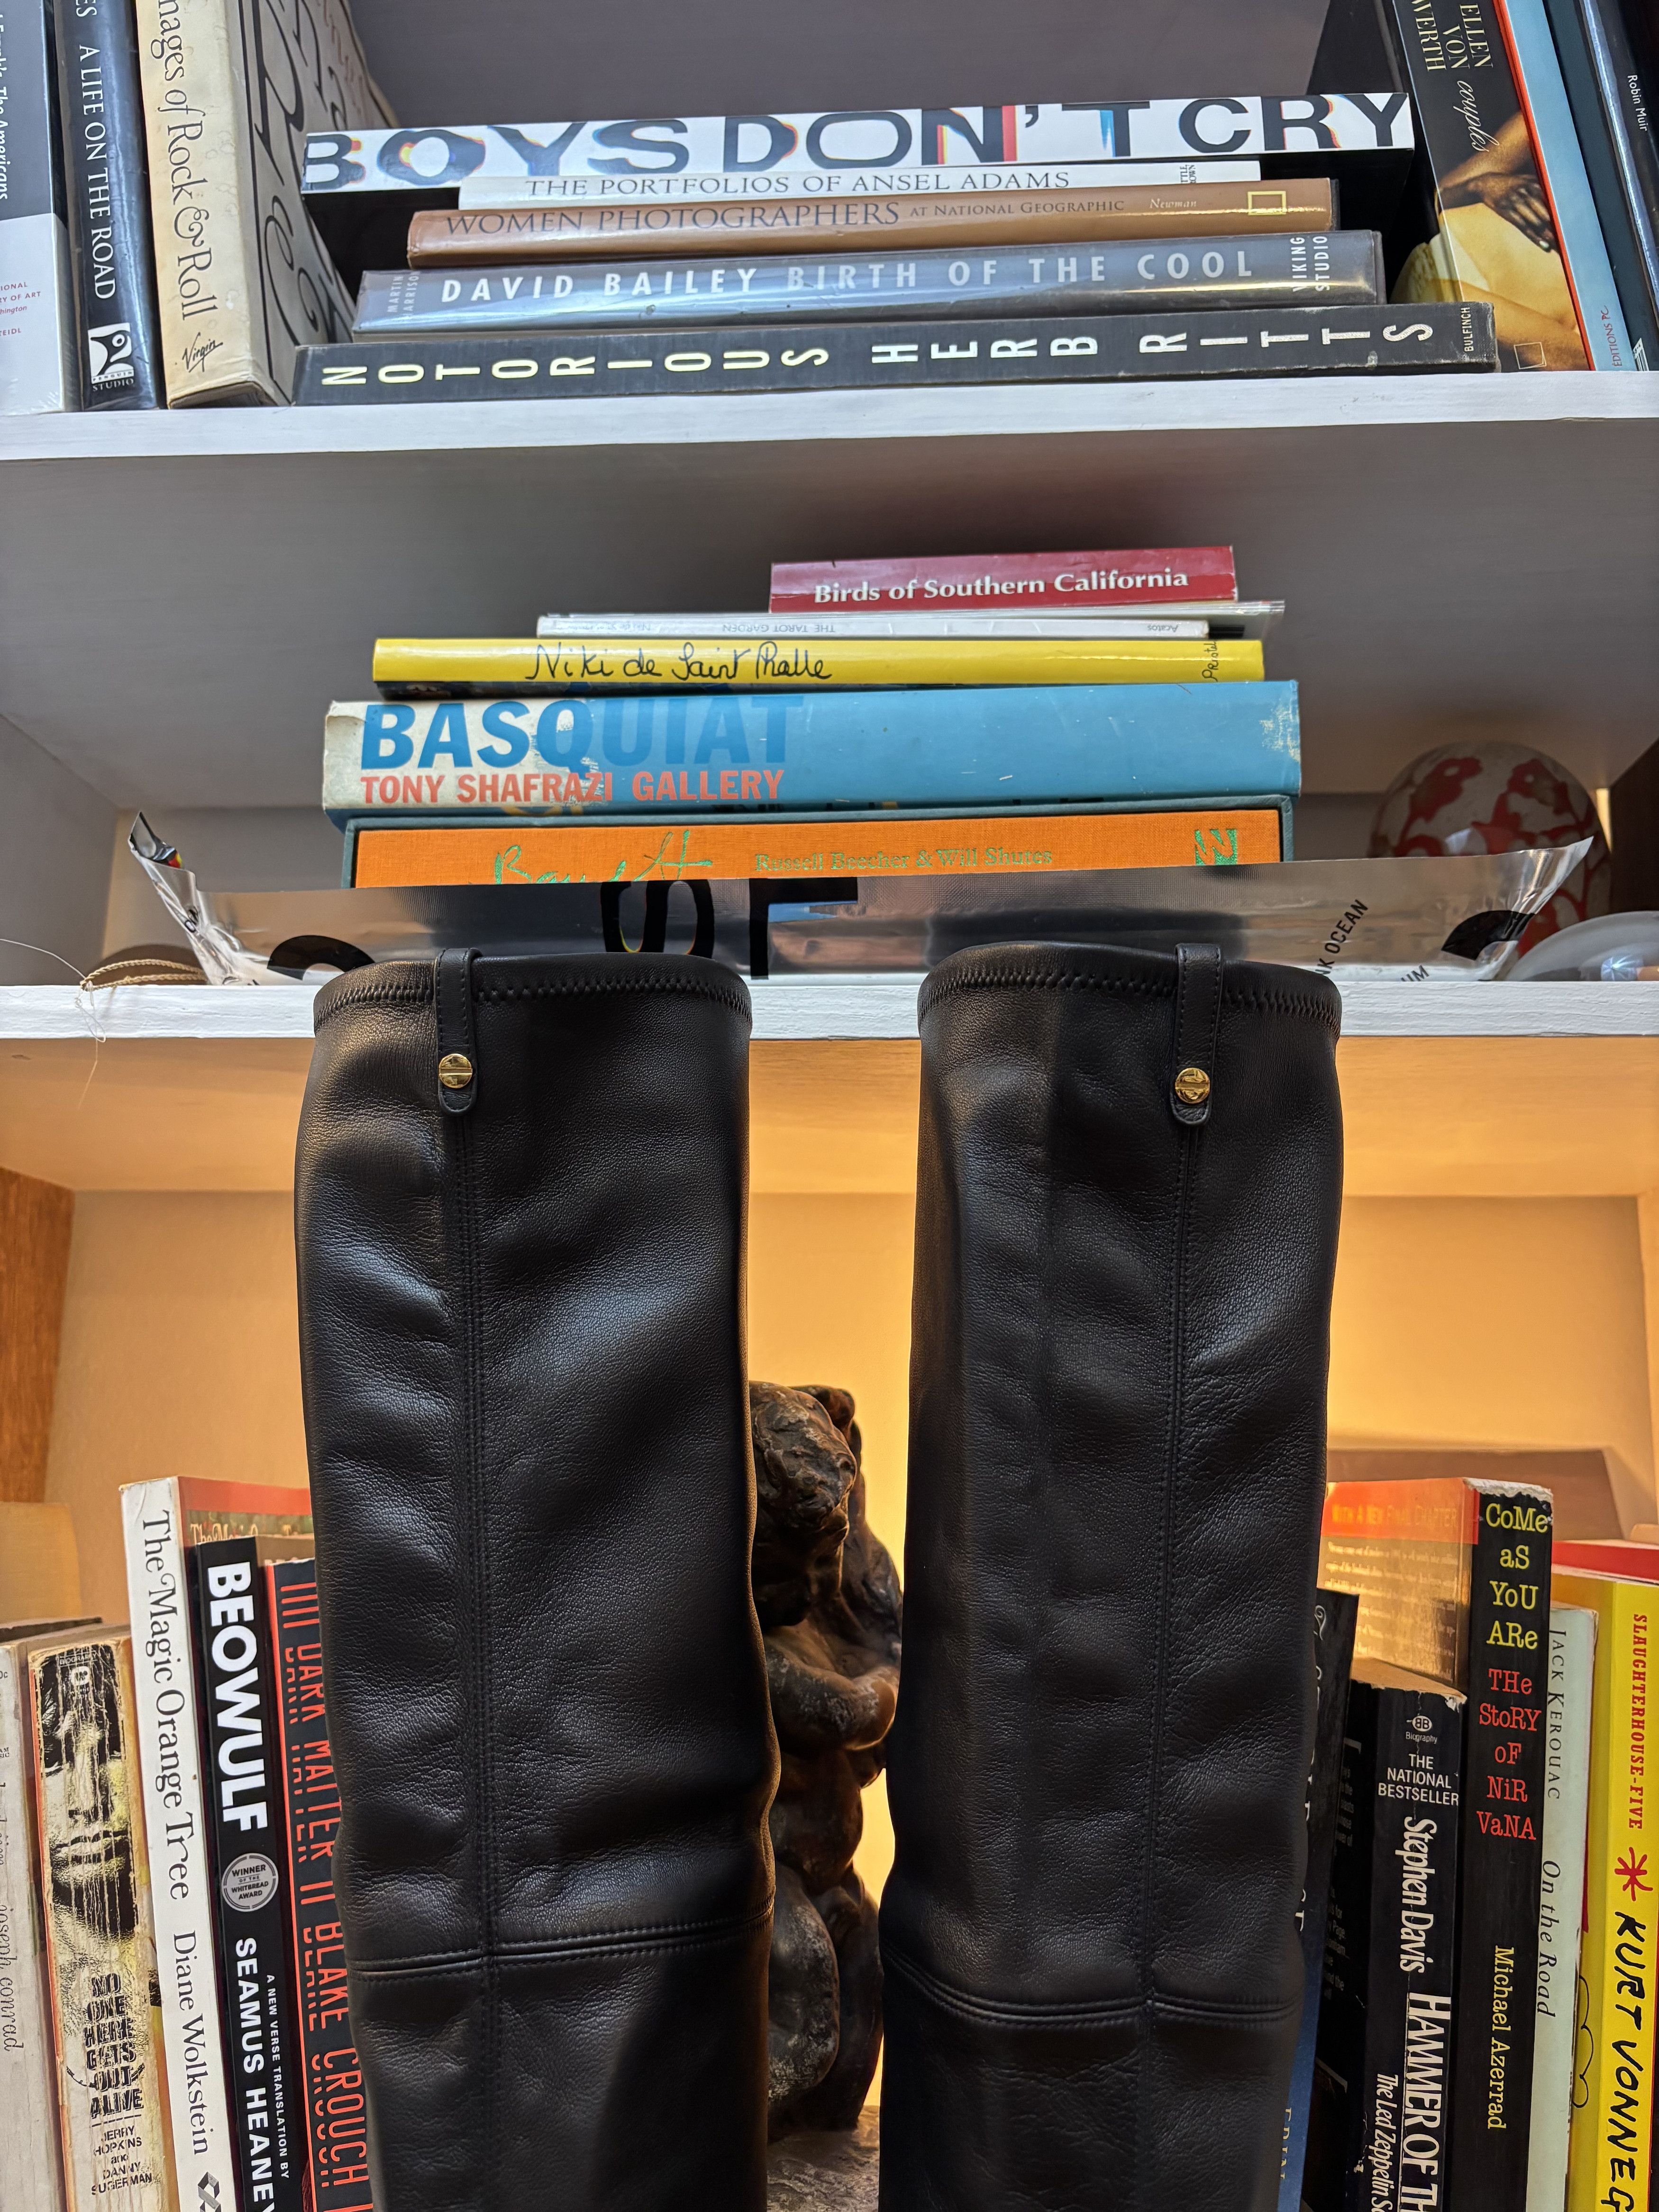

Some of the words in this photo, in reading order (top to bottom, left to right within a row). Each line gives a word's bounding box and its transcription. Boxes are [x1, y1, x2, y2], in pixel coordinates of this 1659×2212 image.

[79, 45, 100, 62] A
[1443, 24, 1470, 69] VON
[1459, 4, 1493, 68] ELLEN
[81, 66, 104, 115] LIFE
[158, 90, 206, 117] of
[1627, 74, 1642, 104] Robin
[1635, 107, 1649, 131] Muir
[1453, 80, 1500, 152] couples
[85, 122, 107, 161] ON
[301, 119, 689, 191] BOYS
[723, 101, 1150, 173] DON'T
[1179, 93, 1410, 154] CRY
[167, 120, 208, 205] Rock
[88, 167, 110, 219] THE
[525, 178, 588, 196] THE
[600, 176, 789, 196] PORTFOLIOS
[803, 175, 841, 191] OF
[852, 173, 950, 191] ANSEL
[961, 171, 1070, 190] ADAMS
[447, 211, 583, 235] WOMEN
[599, 202, 900, 232] PHOTOGRAPHERS
[910, 207, 927, 217] AT
[934, 204, 1012, 216] NATIONAL
[1020, 200, 1125, 213] GEOGRAPHIC
[1149, 198, 1197, 209] Newman
[91, 226, 116, 299] ROAD
[441, 274, 574, 302] DAVID
[603, 268, 757, 296] BAILEY
[787, 263, 917, 291] BIRTH
[948, 260, 997, 286] OF
[1027, 255, 1105, 283] THE
[1137, 250, 1252, 279] COOL
[1290, 237, 1307, 292] VIKING
[1313, 236, 1330, 291] STUDIO
[178, 247, 218, 320] Roll
[387, 276, 403, 313] MARTIN
[1460, 307, 1474, 351] BULFINCH
[182, 332, 223, 373] Virgin
[321, 347, 829, 385] NOTORIOUS
[871, 336, 1098, 364] HERB
[1139, 323, 1434, 354] RITTS
[92, 371, 133, 381] PENGUIN
[92, 378, 134, 391] STUDIO
[814, 580, 881, 604] Birds
[888, 578, 920, 600] of
[923, 573, 1045, 598] Southern
[1053, 567, 1190, 593] California
[722, 623, 770, 633] GARDEN
[773, 623, 809, 633] TAROT
[814, 624, 836, 633] THE
[525, 641, 614, 680] Niki
[623, 647, 663, 678] de
[361, 695, 804, 774] BASQUIAT
[360, 775, 447, 804] TONY
[456, 772, 613, 803] SHAFRAZI
[632, 769, 785, 801] GALLERY
[755, 853, 823, 872] Russell
[830, 850, 909, 871] Beecher
[915, 850, 933, 868] &
[936, 847, 978, 867] Will
[984, 846, 1053, 867] Shutes
[1324, 899, 1368, 954] OCEAN
[1486, 1502, 1549, 1533] CoMe
[143, 1509, 173, 1573] The
[1500, 1545, 1530, 1570] aS
[1489, 1580, 1539, 1610] YoU
[145, 1573, 182, 1684] Magic
[1486, 1620, 1538, 1650] ARe
[1549, 1629, 1567, 1681] JACK
[208, 1561, 268, 1831] BEOWULF
[1488, 1668, 1532, 1695] THe
[1405, 1731, 1438, 1744] Biography
[1628, 1613, 1648, 1830] SLAUGHTERHOUSE-FIVE
[155, 1689, 186, 1809] Orange
[1408, 1753, 1434, 1770] THE
[1546, 1691, 1565, 1800] KEROUAC
[1378, 1782, 1459, 1806] BESTSELLER
[1387, 1767, 1452, 1789] NATIONAL
[165, 1811, 195, 1900] Tree
[232, 1864, 266, 1876] WINNER
[1395, 1816, 1437, 1906] Stephen
[231, 1881, 269, 1893] WHITBREAD
[238, 1890, 263, 1900] AWARD
[1542, 1859, 1561, 1893] On
[1400, 1910, 1434, 1974] Davis
[1540, 1903, 1559, 1943] the
[91, 1973, 121, 1997] NO
[173, 1929, 198, 2011] Diane
[266, 1975, 275, 1983] A
[1492, 1945, 1514, 2031] Michael
[1537, 1951, 1557, 2018] Road
[1613, 1911, 1646, 2031] KURT
[0, 1977, 24, 2051] conrad
[87, 1994, 128, 2021] ONE
[235, 1937, 264, 2074] SEAMUS
[268, 1988, 278, 2015] NEW
[83, 2017, 135, 2048] HERE
[270, 2021, 281, 2061] VERSE
[86, 2041, 137, 2071] GETS
[1404, 1992, 1451, 2129] HAMMER
[94, 2065, 133, 2092] OUT
[182, 2012, 215, 2156] Wolkstein
[1376, 2073, 1398, 2099] The
[1487, 2037, 1511, 2130] Azerrad
[90, 2088, 144, 2120] ALIVE
[273, 2066, 288, 2157] TRANSLATION
[323, 2048, 370, 2186] CROUCH
[1375, 2099, 1397, 2130] Led
[100, 2125, 135, 2142] JERRY
[1601, 2040, 1644, 2212] VONNEG
[93, 2136, 142, 2157] HOPKNS
[1368, 2131, 1396, 2195] Zeppelin
[1402, 2133, 1440, 2176] OF
[281, 2162, 290, 2179] BY
